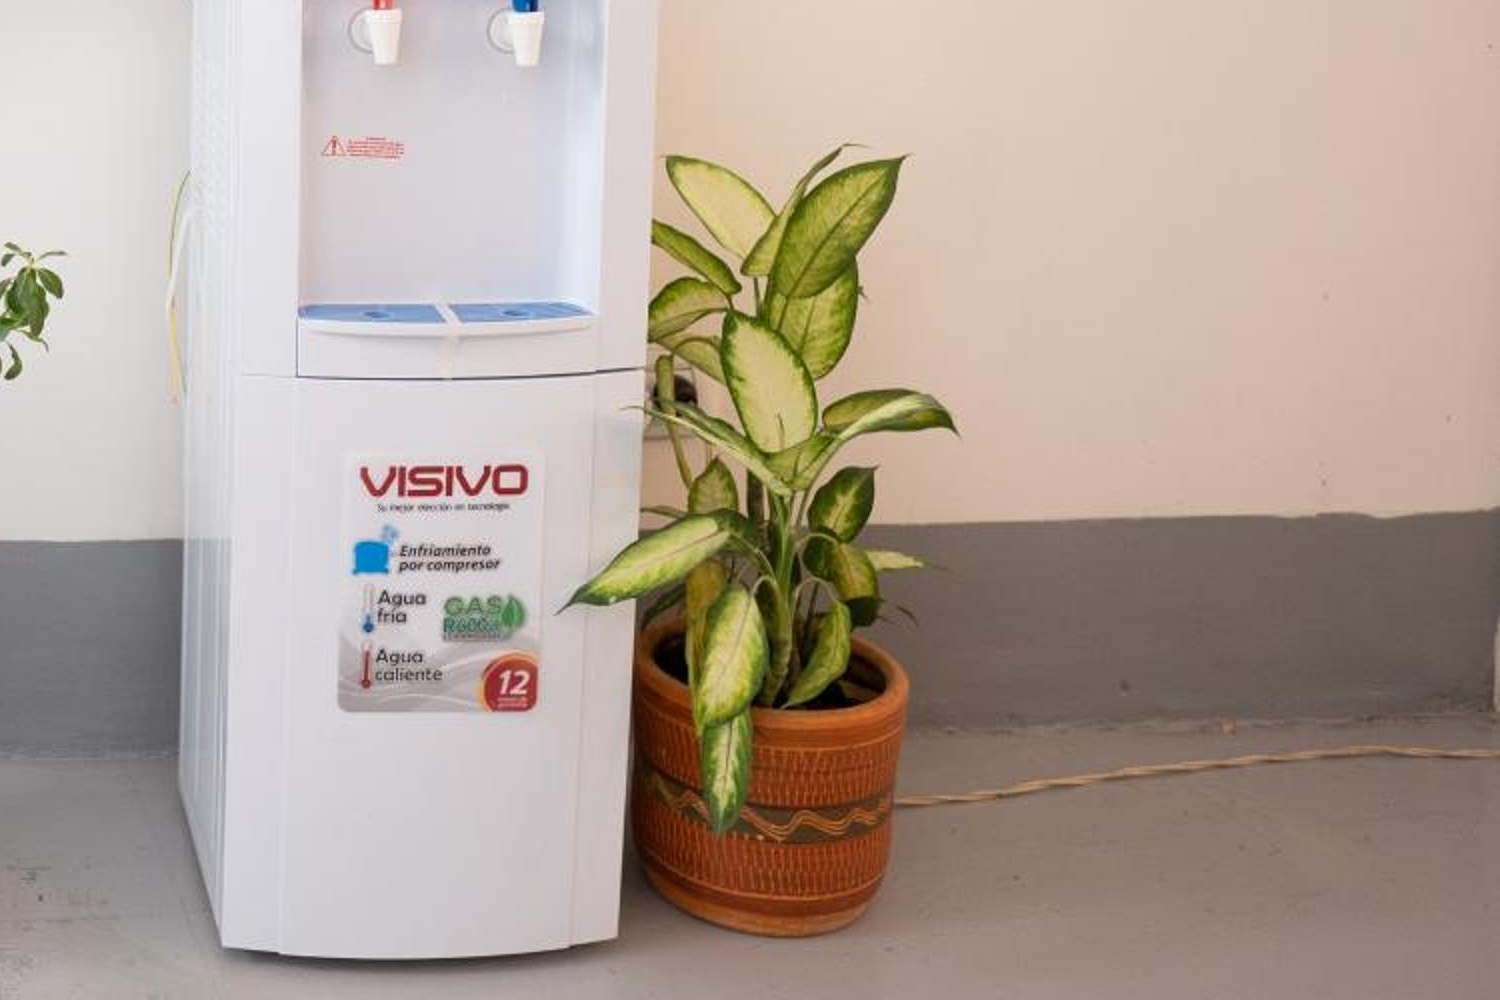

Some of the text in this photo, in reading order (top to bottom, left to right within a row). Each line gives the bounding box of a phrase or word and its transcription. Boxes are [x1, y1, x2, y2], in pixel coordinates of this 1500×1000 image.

[359, 464, 529, 498] VISIVO
[399, 543, 492, 558] Enfriamiento
[398, 558, 501, 574] por compresor
[378, 590, 427, 607] Agua
[443, 596, 502, 616] GAS
[377, 607, 407, 623] fría
[375, 648, 424, 666] Agua
[375, 667, 443, 681] caliente
[499, 669, 531, 696] 12
